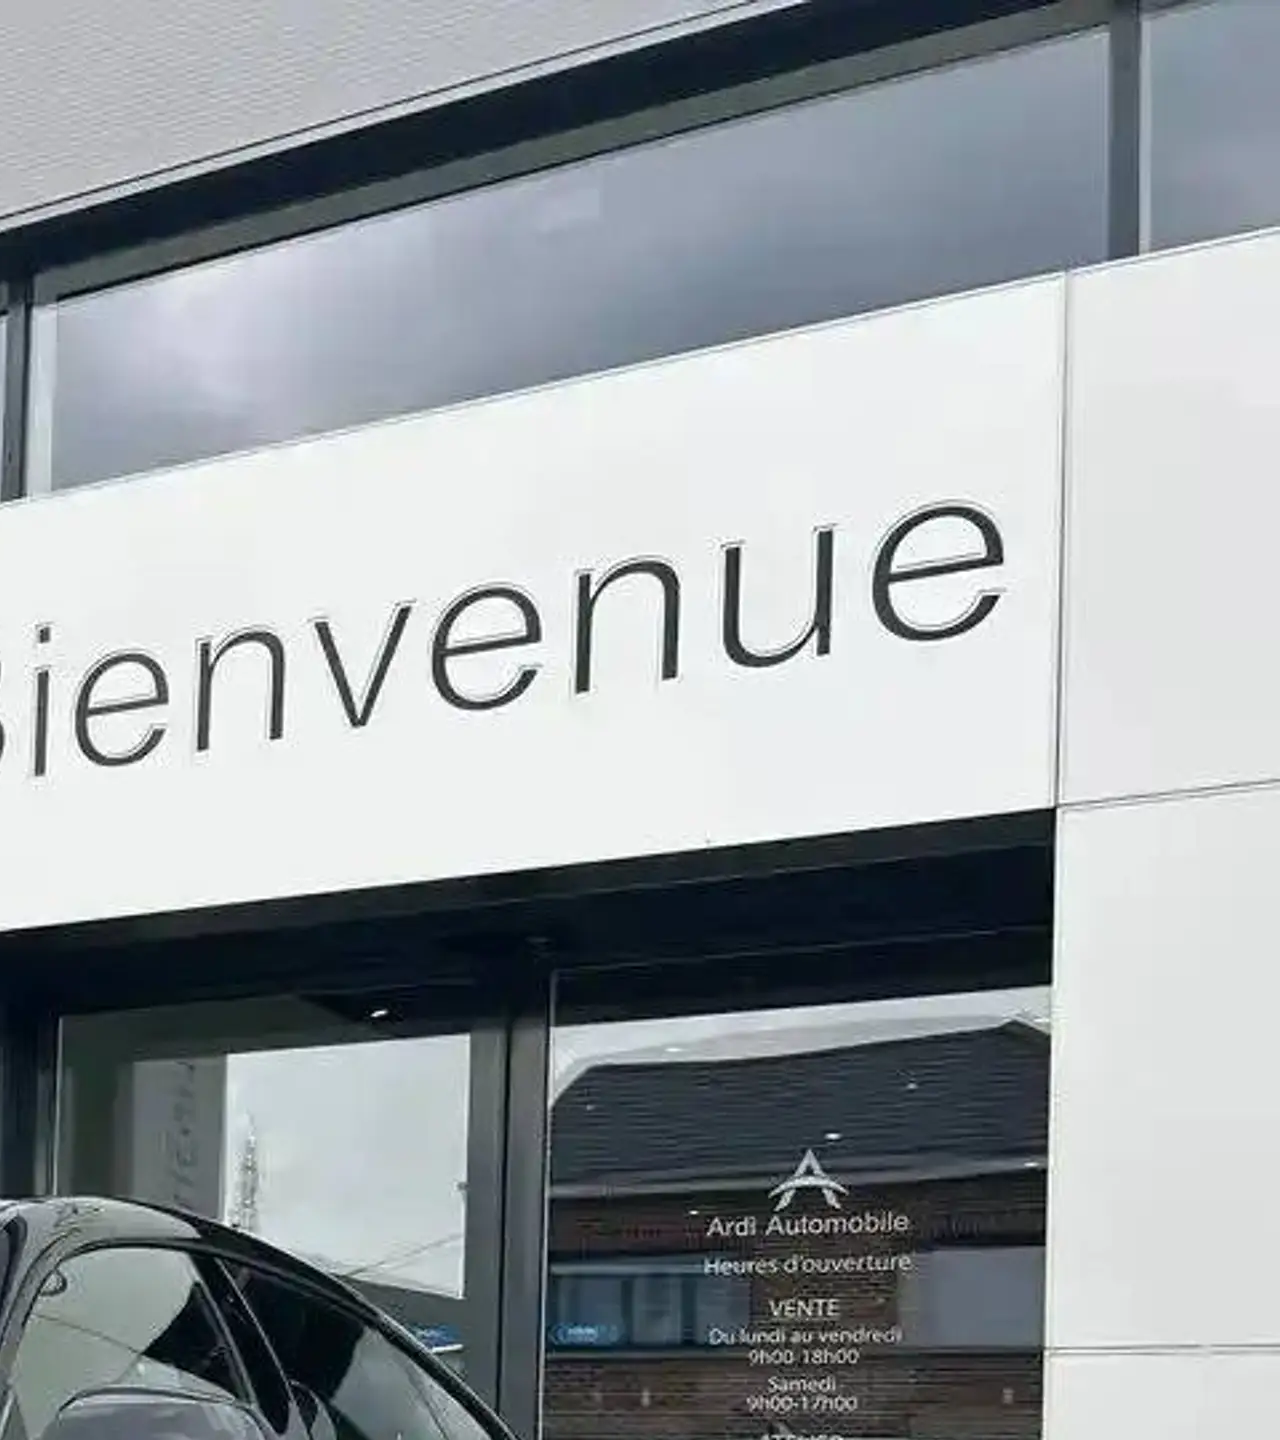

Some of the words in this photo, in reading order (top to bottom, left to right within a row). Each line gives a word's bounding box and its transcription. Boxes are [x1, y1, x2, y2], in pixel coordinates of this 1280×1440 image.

[706, 1216, 756, 1237] Ardi
[765, 1211, 910, 1236] Automobile
[704, 1257, 777, 1275] Heures
[783, 1252, 912, 1274] d'ouverture
[768, 1300, 840, 1316] VENTE
[709, 1328, 735, 1345] Du
[740, 1326, 785, 1343] lundi
[791, 1331, 812, 1343] au
[818, 1327, 902, 1343] vendredi
[767, 1375, 836, 1393] Samedi
